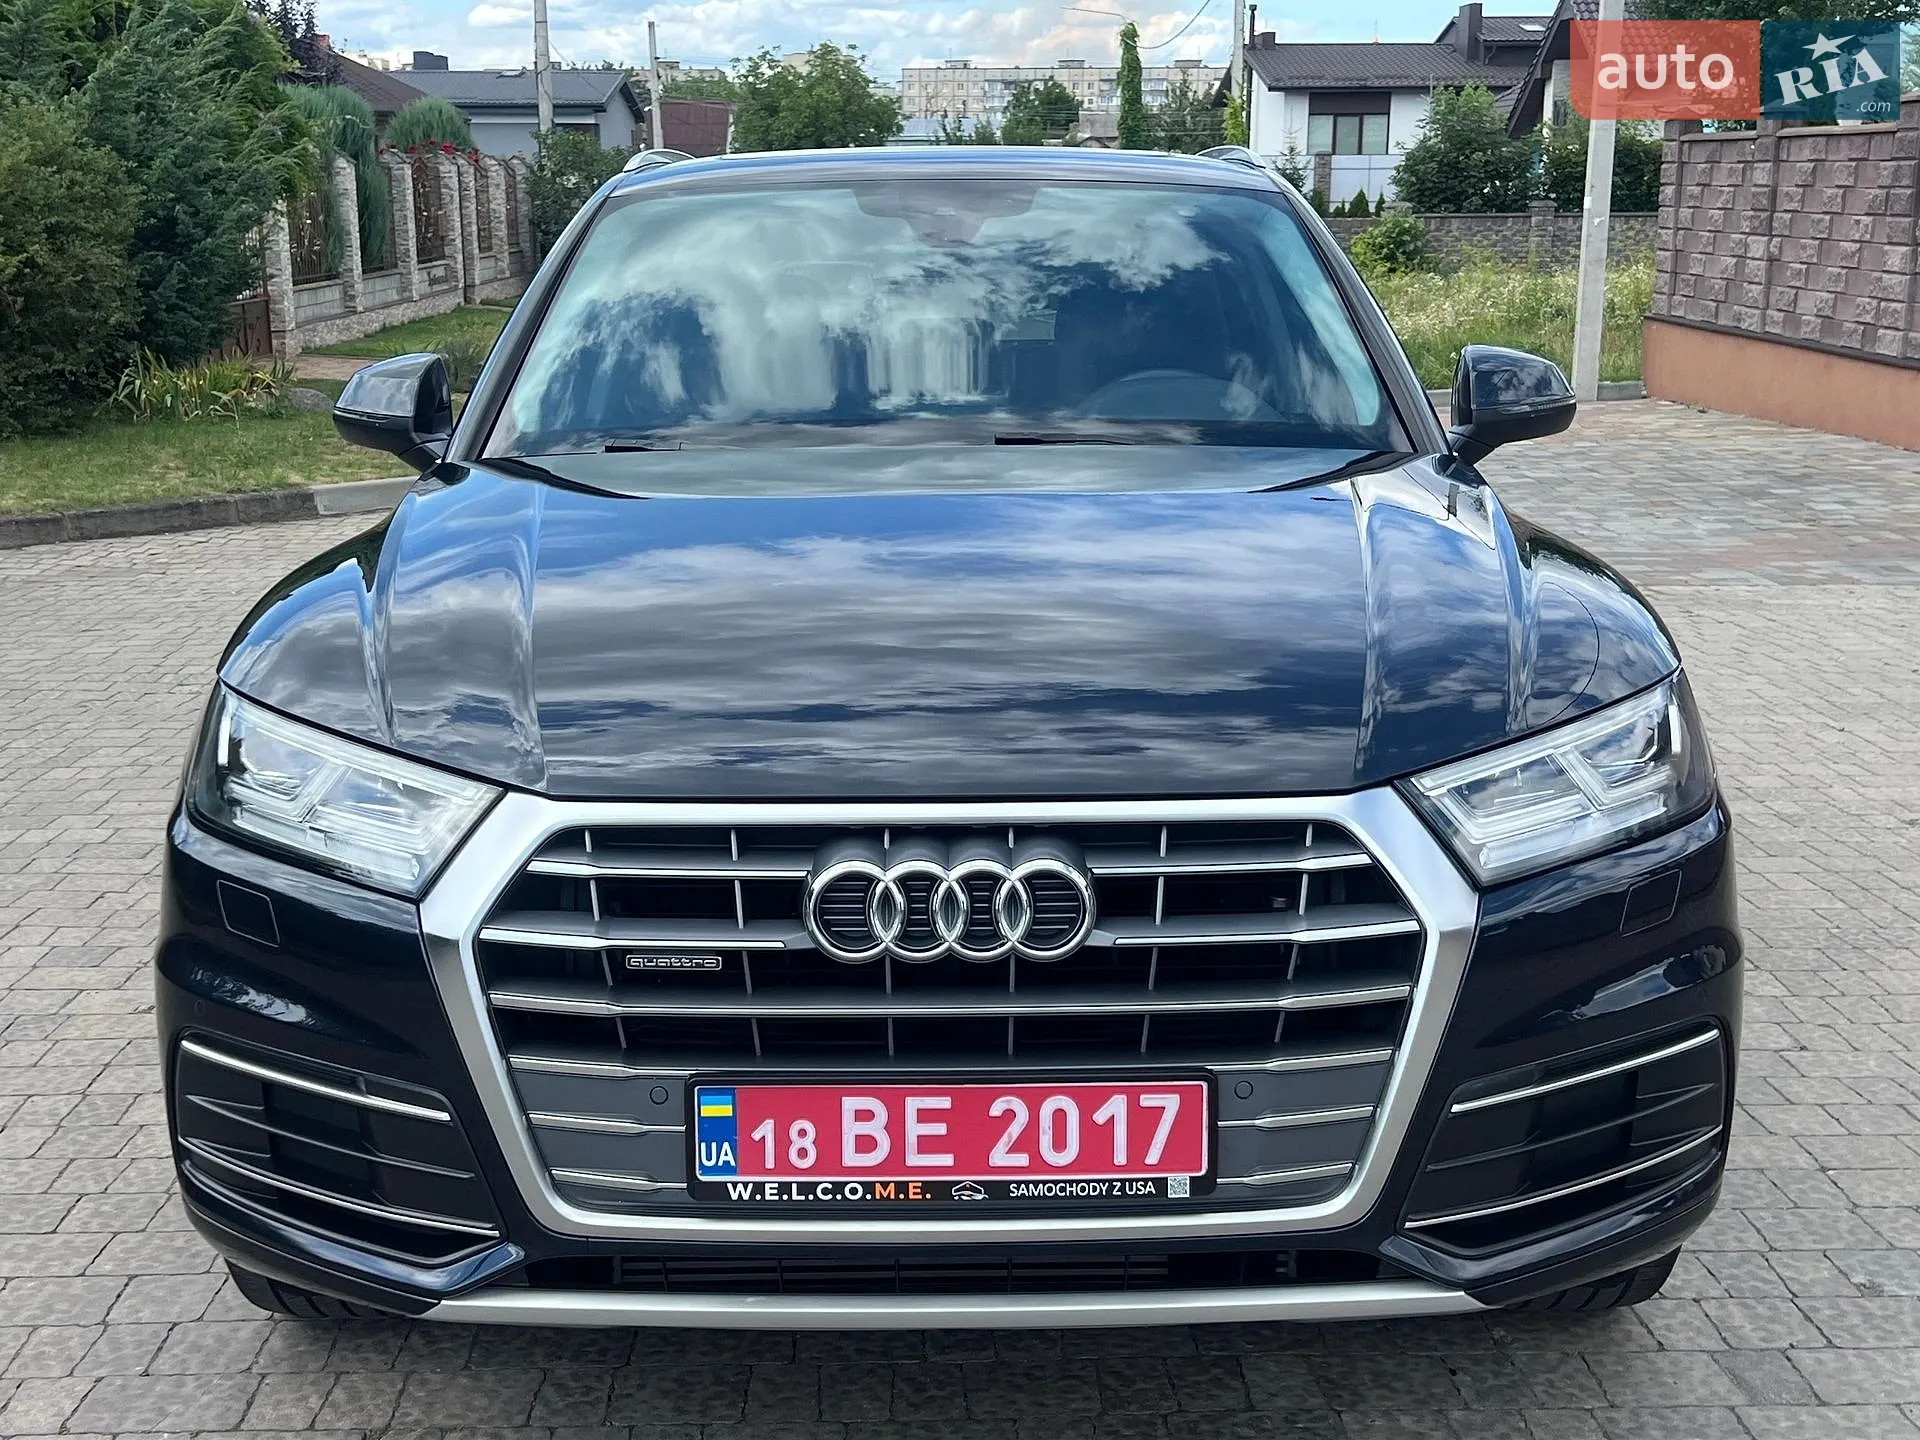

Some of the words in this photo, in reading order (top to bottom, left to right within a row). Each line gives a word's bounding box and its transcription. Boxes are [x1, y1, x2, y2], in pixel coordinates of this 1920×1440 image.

[630, 957, 717, 968] quattro
[750, 1119, 817, 1169] 18
[841, 1096, 954, 1168] BE
[988, 1093, 1181, 1168] 2017
[700, 1142, 736, 1167] UA
[726, 1182, 932, 1201] W.E.L.C.O.M.E.
[1009, 1182, 1108, 1197] SAMOCHODY
[1112, 1182, 1123, 1196] Z
[1125, 1181, 1156, 1195] USA
